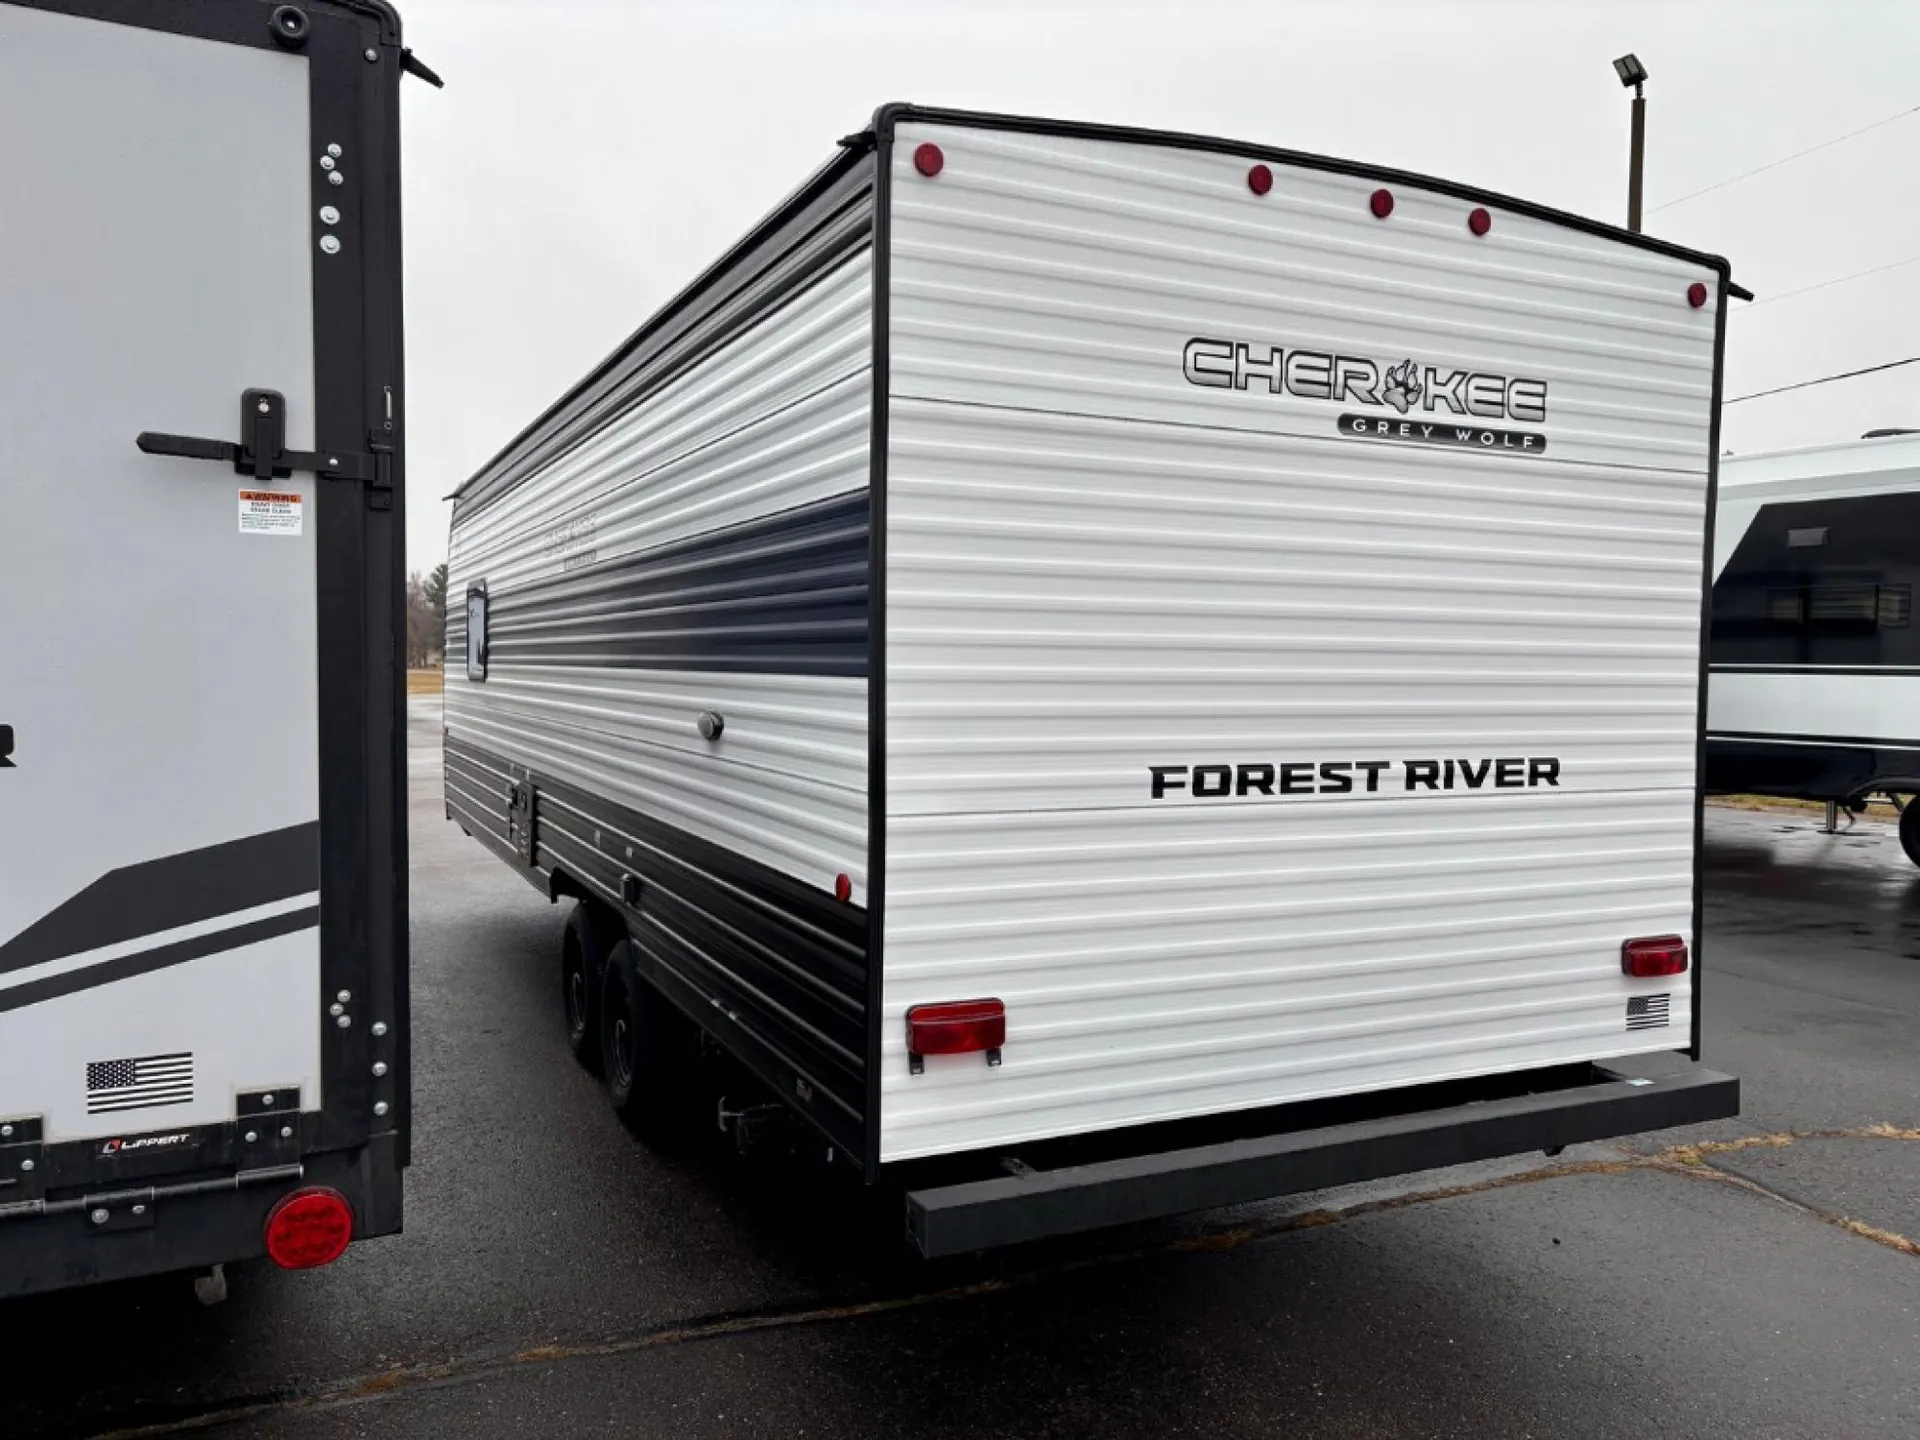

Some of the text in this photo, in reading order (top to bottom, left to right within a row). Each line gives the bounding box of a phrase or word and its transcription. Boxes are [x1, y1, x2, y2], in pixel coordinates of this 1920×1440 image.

[1182, 337, 1548, 423] CHEROKEE
[1351, 417, 1536, 449] GREY WOLF
[1148, 757, 1560, 799] FOREST RIVER
[121, 1133, 190, 1150] LIPPERT
